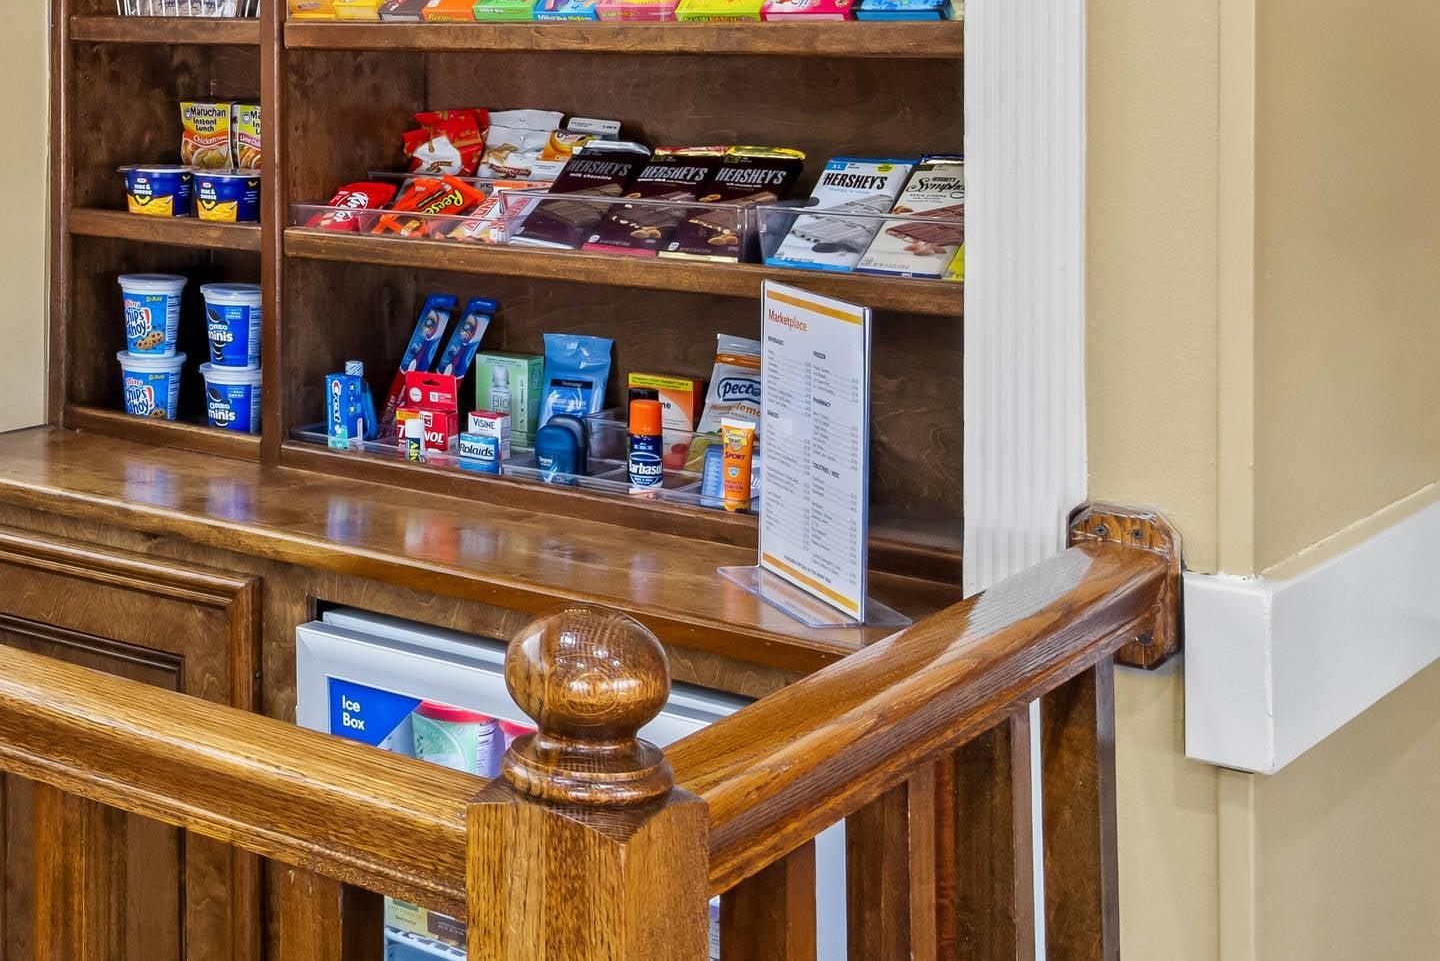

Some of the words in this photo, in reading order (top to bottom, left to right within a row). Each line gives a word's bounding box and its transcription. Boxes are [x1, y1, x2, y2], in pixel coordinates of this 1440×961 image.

[190, 107, 227, 118] Maruchan
[193, 118, 217, 126] Instant
[567, 158, 633, 176] HERSHEY'S
[640, 166, 709, 181] HERSHEY'S
[715, 168, 787, 185] HERSHEY'S
[822, 173, 889, 190] HERSHEY'S
[208, 323, 229, 331] OREO
[768, 309, 808, 332] Marketplace
[208, 330, 234, 343] minis
[210, 402, 230, 410] OREO
[332, 380, 342, 423] Crest
[493, 394, 511, 408] Bio
[812, 396, 831, 408] PHARMACY
[209, 409, 236, 421] minis
[473, 418, 496, 430] VISINE
[398, 425, 444, 443] TNOL
[460, 443, 494, 457] Rolaids
[725, 451, 746, 460] SPORT
[342, 695, 361, 713] Ice
[342, 713, 365, 731] Box
